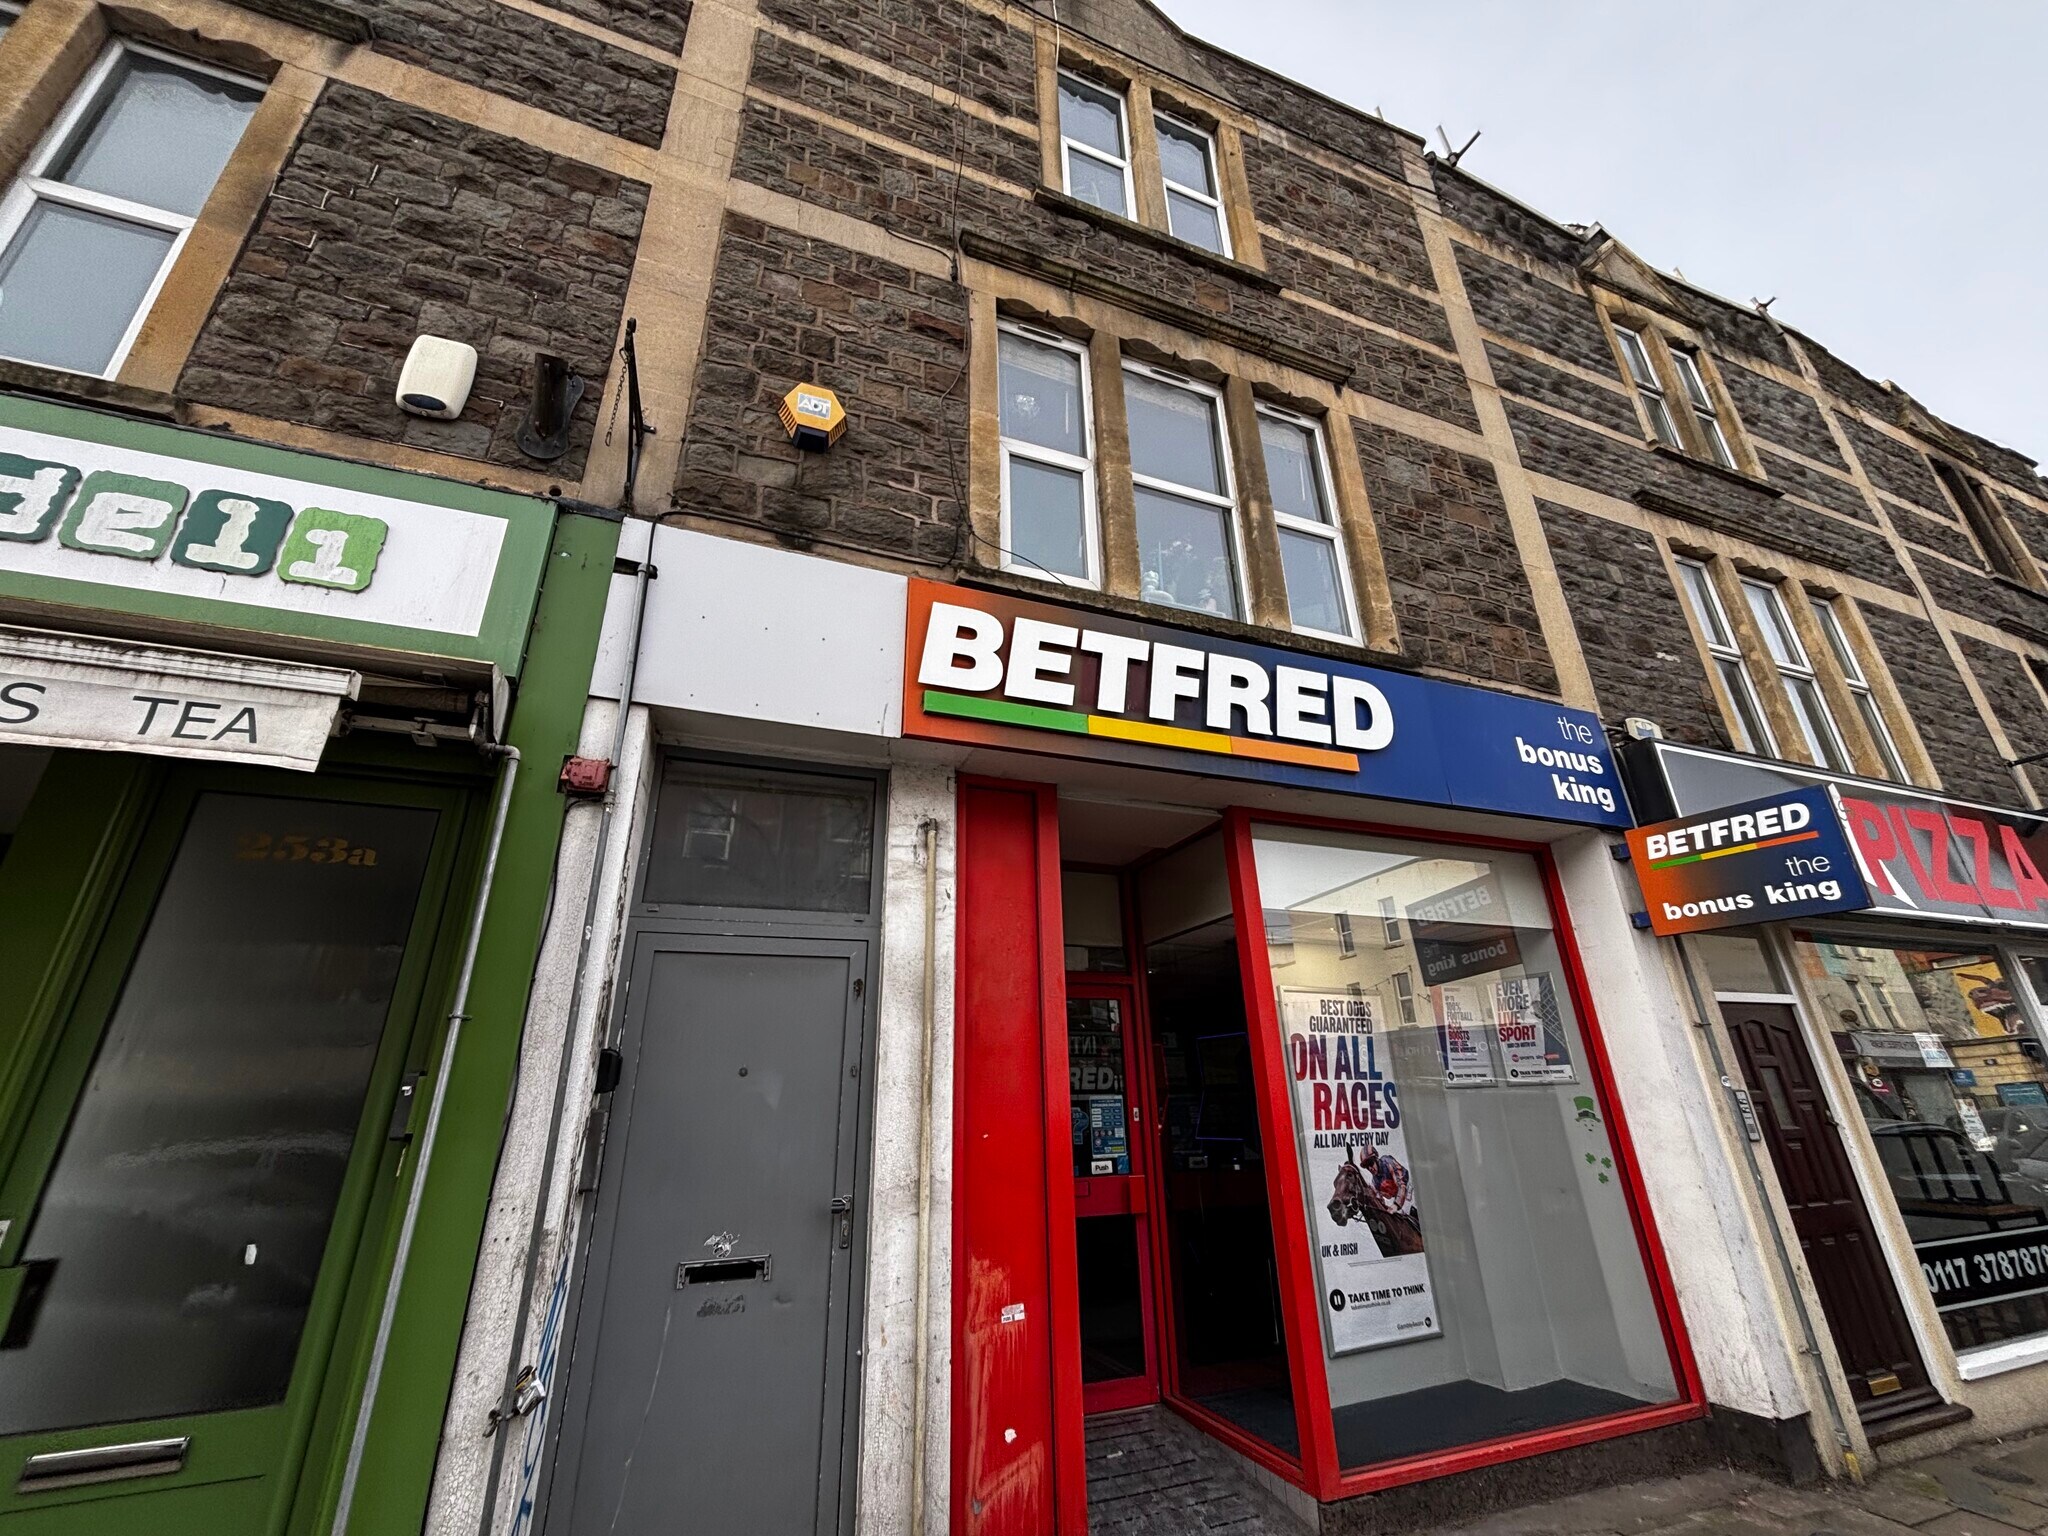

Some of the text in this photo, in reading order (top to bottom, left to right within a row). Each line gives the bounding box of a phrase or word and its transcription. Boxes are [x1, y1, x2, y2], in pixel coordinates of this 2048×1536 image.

[799, 398, 830, 415] ADT
[917, 600, 1396, 751] BETFRED
[132, 695, 258, 744] TEA
[1556, 716, 1594, 745] the
[1515, 736, 1604, 775] bonus
[1551, 773, 1616, 813] king
[1646, 802, 1811, 861] BETFRED
[1785, 854, 1832, 878] the
[1840, 797, 2048, 912] PIZZA
[1662, 879, 1842, 921] bonus king
[1496, 980, 1524, 997] EVEN
[1320, 999, 1372, 1018] BEST ODDS
[1497, 994, 1529, 1012] MORE
[1309, 1015, 1373, 1034] GUARANTEED
[1498, 1011, 1521, 1027] LIVE
[1499, 1024, 1537, 1042] SPORT
[1290, 1032, 1383, 1081] ON ALL
[1313, 1081, 1400, 1131] RACES
[1314, 1133, 1330, 1148] ALL
[1350, 1131, 1374, 1147] EVERY
[1375, 1131, 1389, 1146] DAY
[1095, 1163, 1109, 1172] Push
[1321, 1242, 1358, 1258] UK & IRISH
[1921, 1257, 1970, 1294] 0117
[1348, 1283, 1426, 1304] TAKE TIME TO THINK
